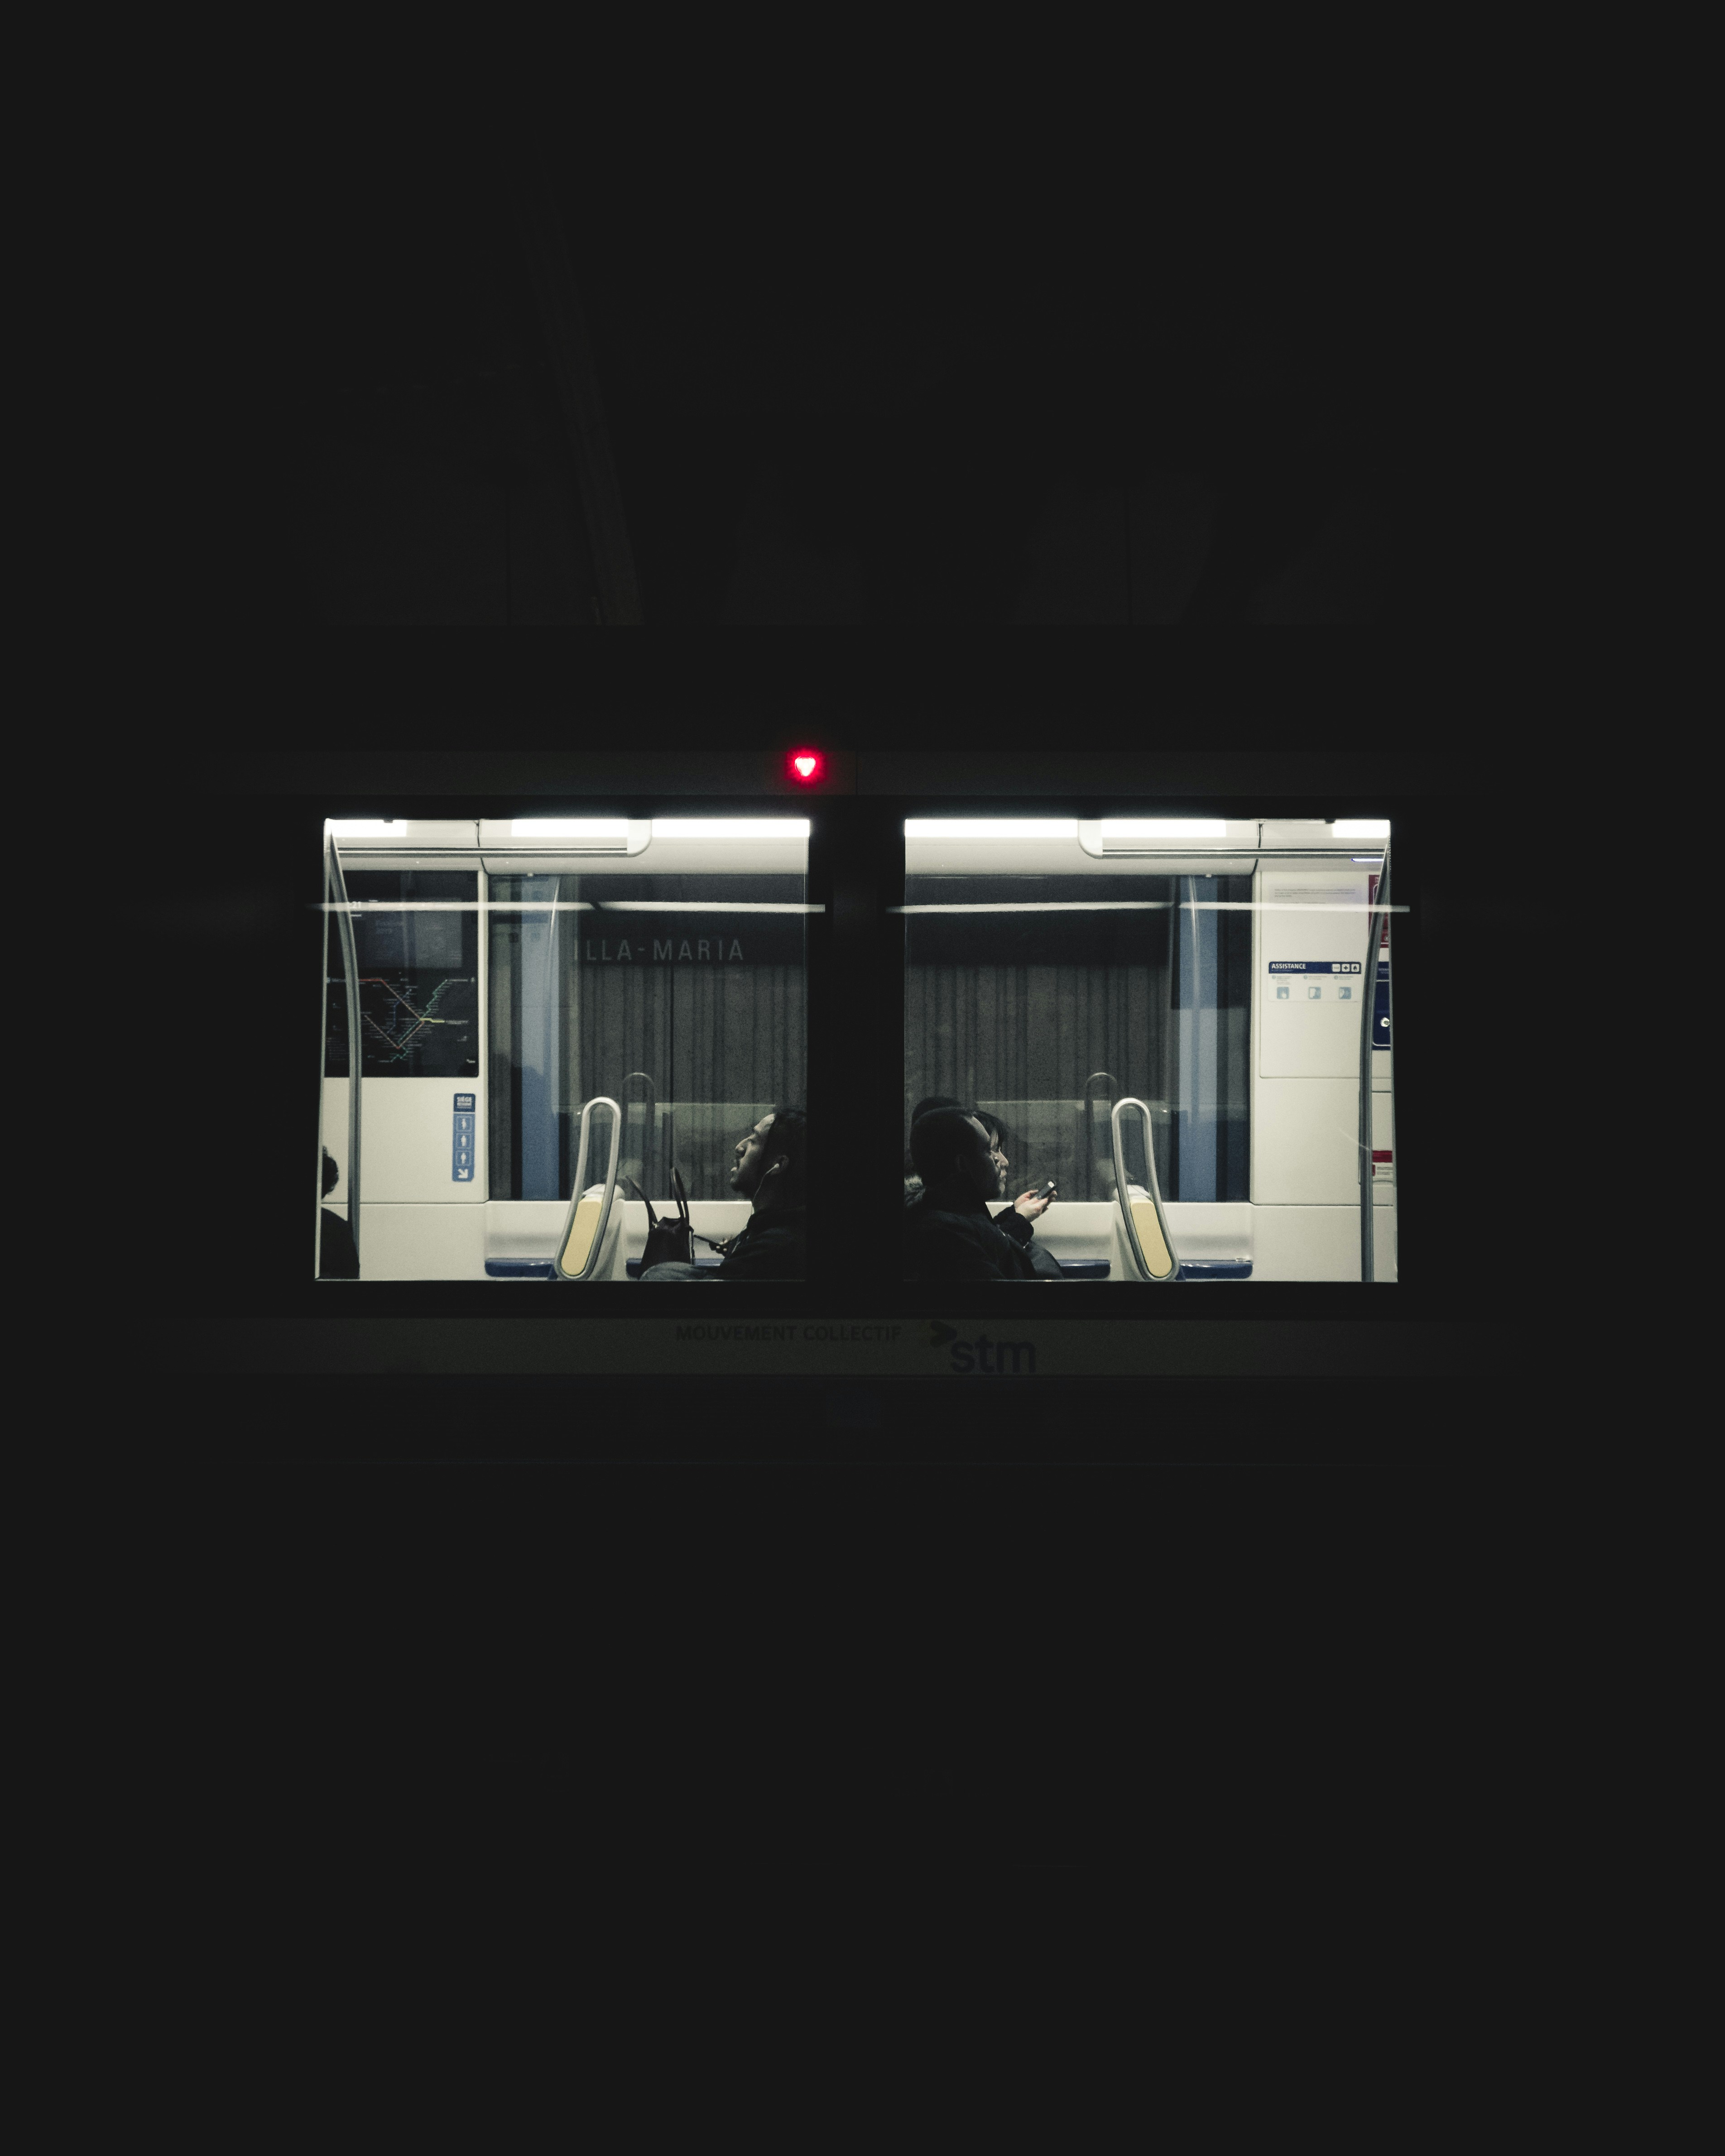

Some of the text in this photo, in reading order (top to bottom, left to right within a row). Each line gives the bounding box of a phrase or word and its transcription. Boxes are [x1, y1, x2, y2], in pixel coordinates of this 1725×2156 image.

[675, 1325, 902, 1342] MOUVEMENT COLLECTIF
[950, 1334, 1036, 1374] stm
